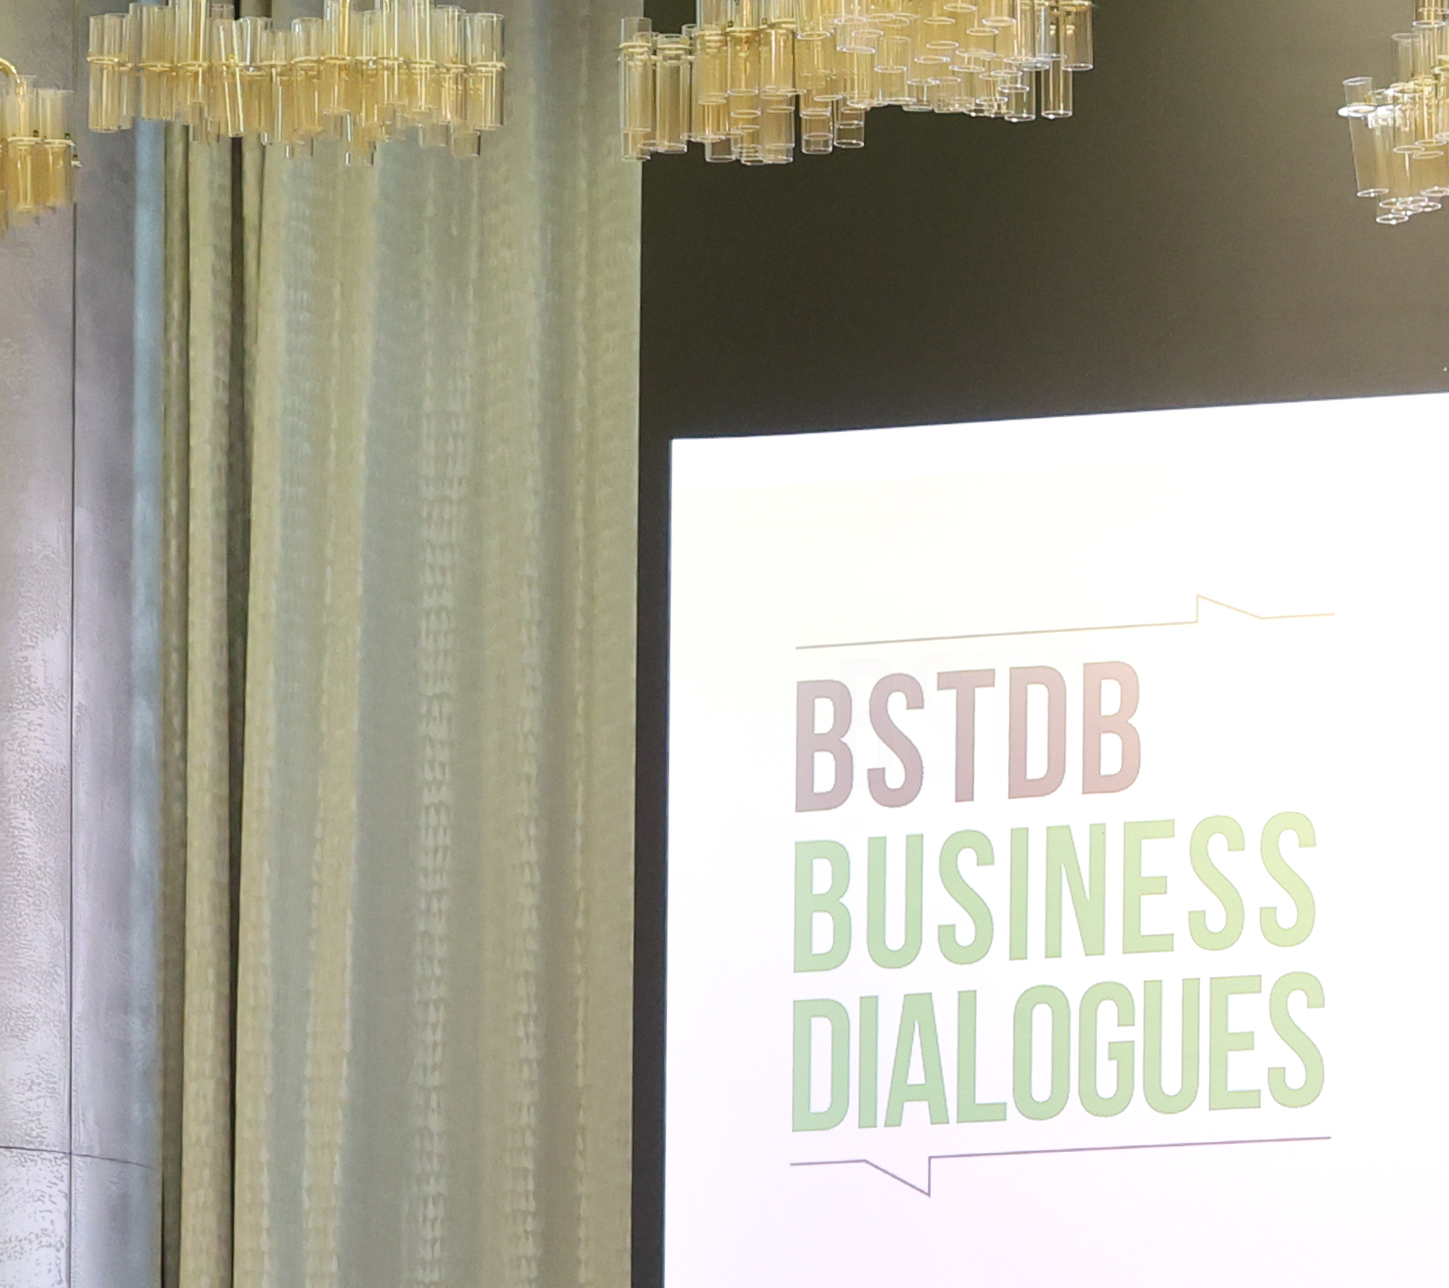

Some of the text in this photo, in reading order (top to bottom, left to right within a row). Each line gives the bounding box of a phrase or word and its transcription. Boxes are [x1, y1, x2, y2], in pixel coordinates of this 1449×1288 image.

[795, 661, 1141, 813] BSTDB
[793, 811, 1316, 973] BUSINESS
[792, 971, 1325, 1132] DIALOGUES
